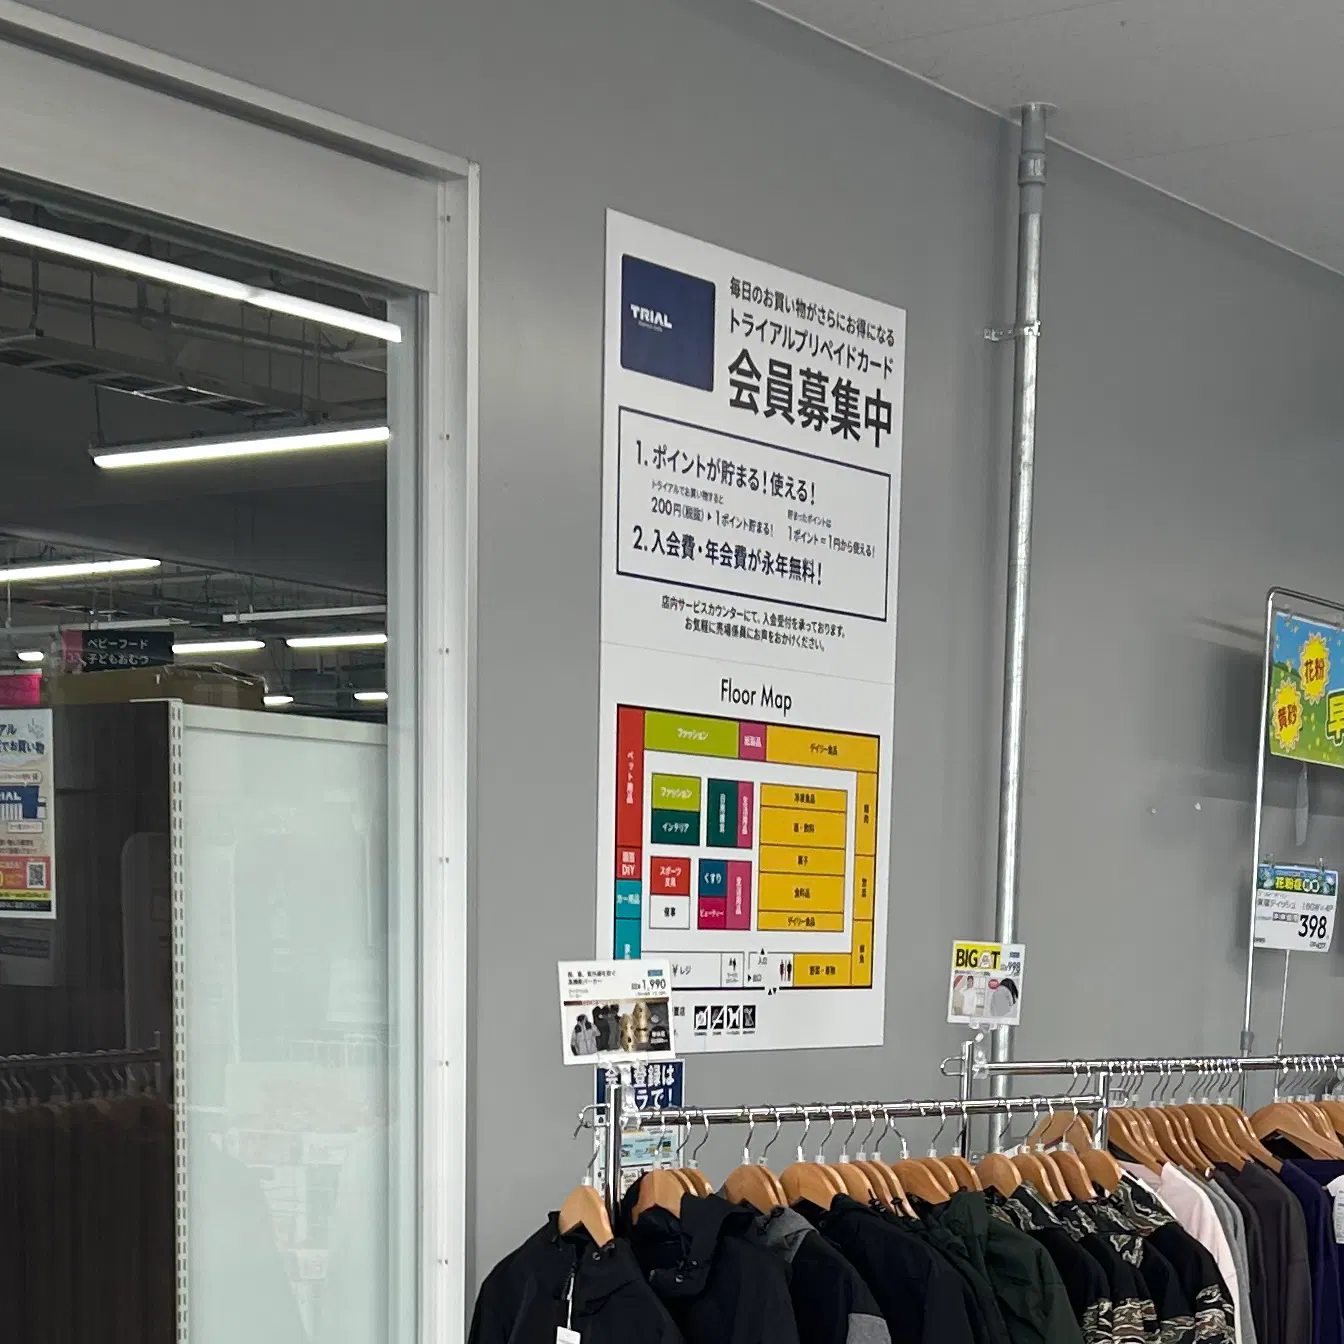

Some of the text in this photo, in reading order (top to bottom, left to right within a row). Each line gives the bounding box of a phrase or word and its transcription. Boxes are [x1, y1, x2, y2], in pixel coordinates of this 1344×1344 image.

[630, 303, 673, 330] TRIAL
[729, 275, 895, 348] 毎日のお買い物がさらにお得になる
[730, 307, 894, 381] トライアルプリペイドカード
[727, 347, 893, 449] 会員募集中
[1303, 657, 1325, 684] 花粉
[720, 678, 793, 717] Floor Map
[1277, 704, 1297, 732] 黄砂
[703, 873, 722, 885] くすり
[1298, 914, 1327, 939] 398
[956, 948, 978, 968] BIG
